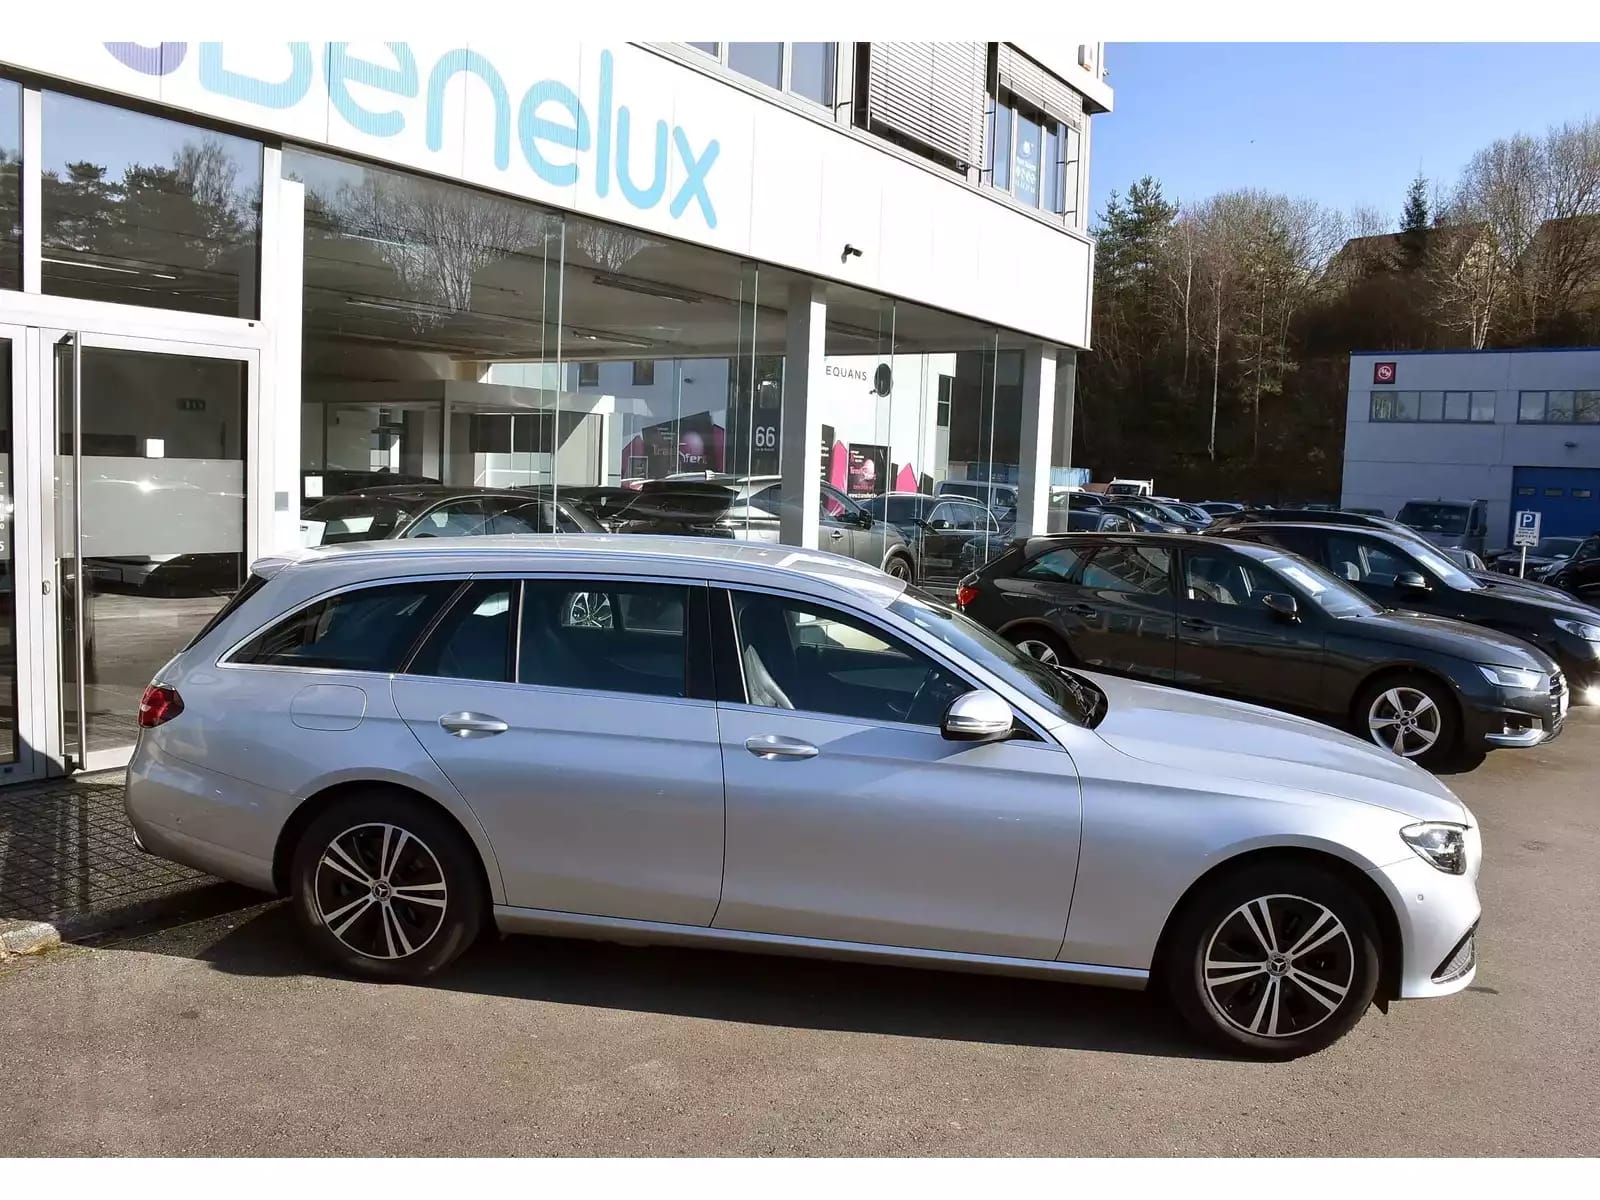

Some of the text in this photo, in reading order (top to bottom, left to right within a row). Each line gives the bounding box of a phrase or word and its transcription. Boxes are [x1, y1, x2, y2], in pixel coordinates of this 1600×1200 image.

[825, 365, 867, 381] EQUANS
[755, 426, 775, 447] 66
[1522, 514, 1533, 527] P
